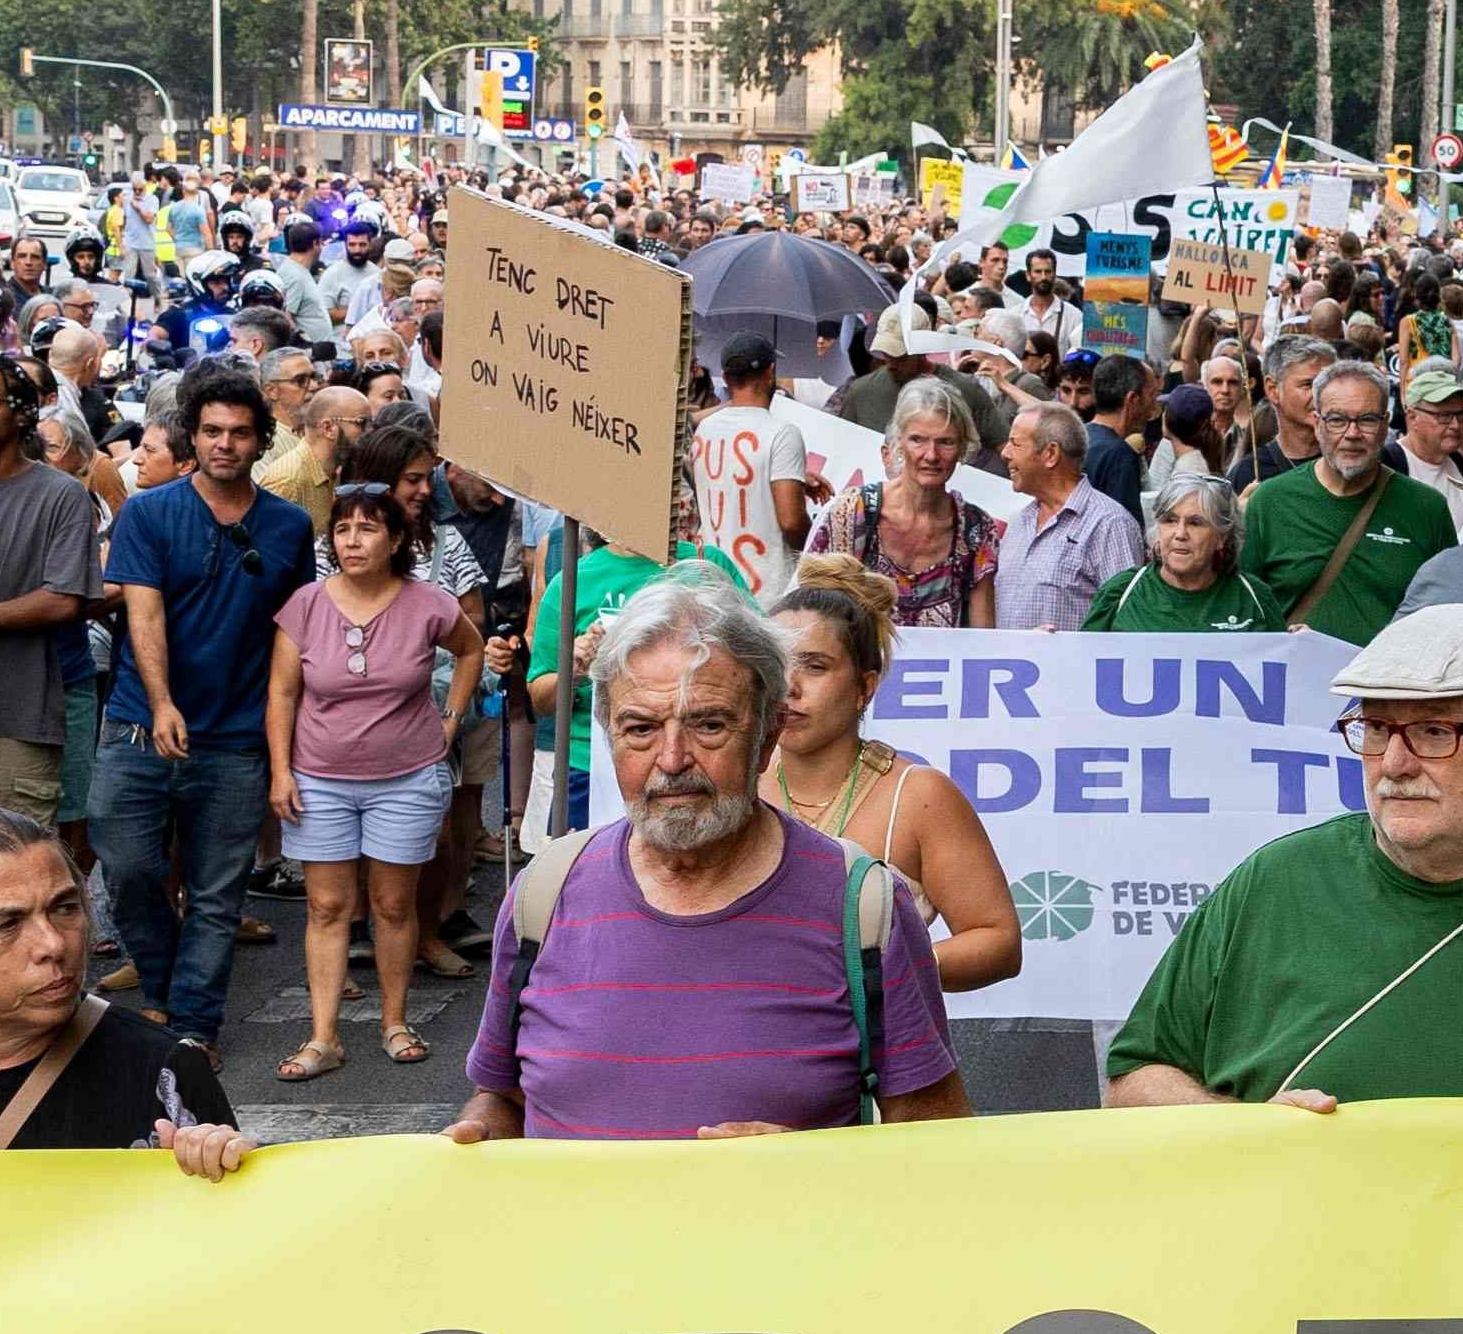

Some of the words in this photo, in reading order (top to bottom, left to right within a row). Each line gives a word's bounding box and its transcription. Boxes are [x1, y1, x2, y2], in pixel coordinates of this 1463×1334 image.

[286, 107, 419, 132] APARCAMENT
[1439, 145, 1455, 156] 50
[487, 247, 537, 294] TENC
[556, 277, 614, 330] DRET
[1173, 270, 1193, 289] AL
[1206, 269, 1257, 296] LÍMIT
[489, 310, 504, 345] A
[471, 359, 497, 386] ON
[1095, 658, 1287, 725] UN
[897, 747, 1210, 815] DEL
[1111, 880, 1221, 907] FEDER
[1112, 910, 1153, 936] DE
